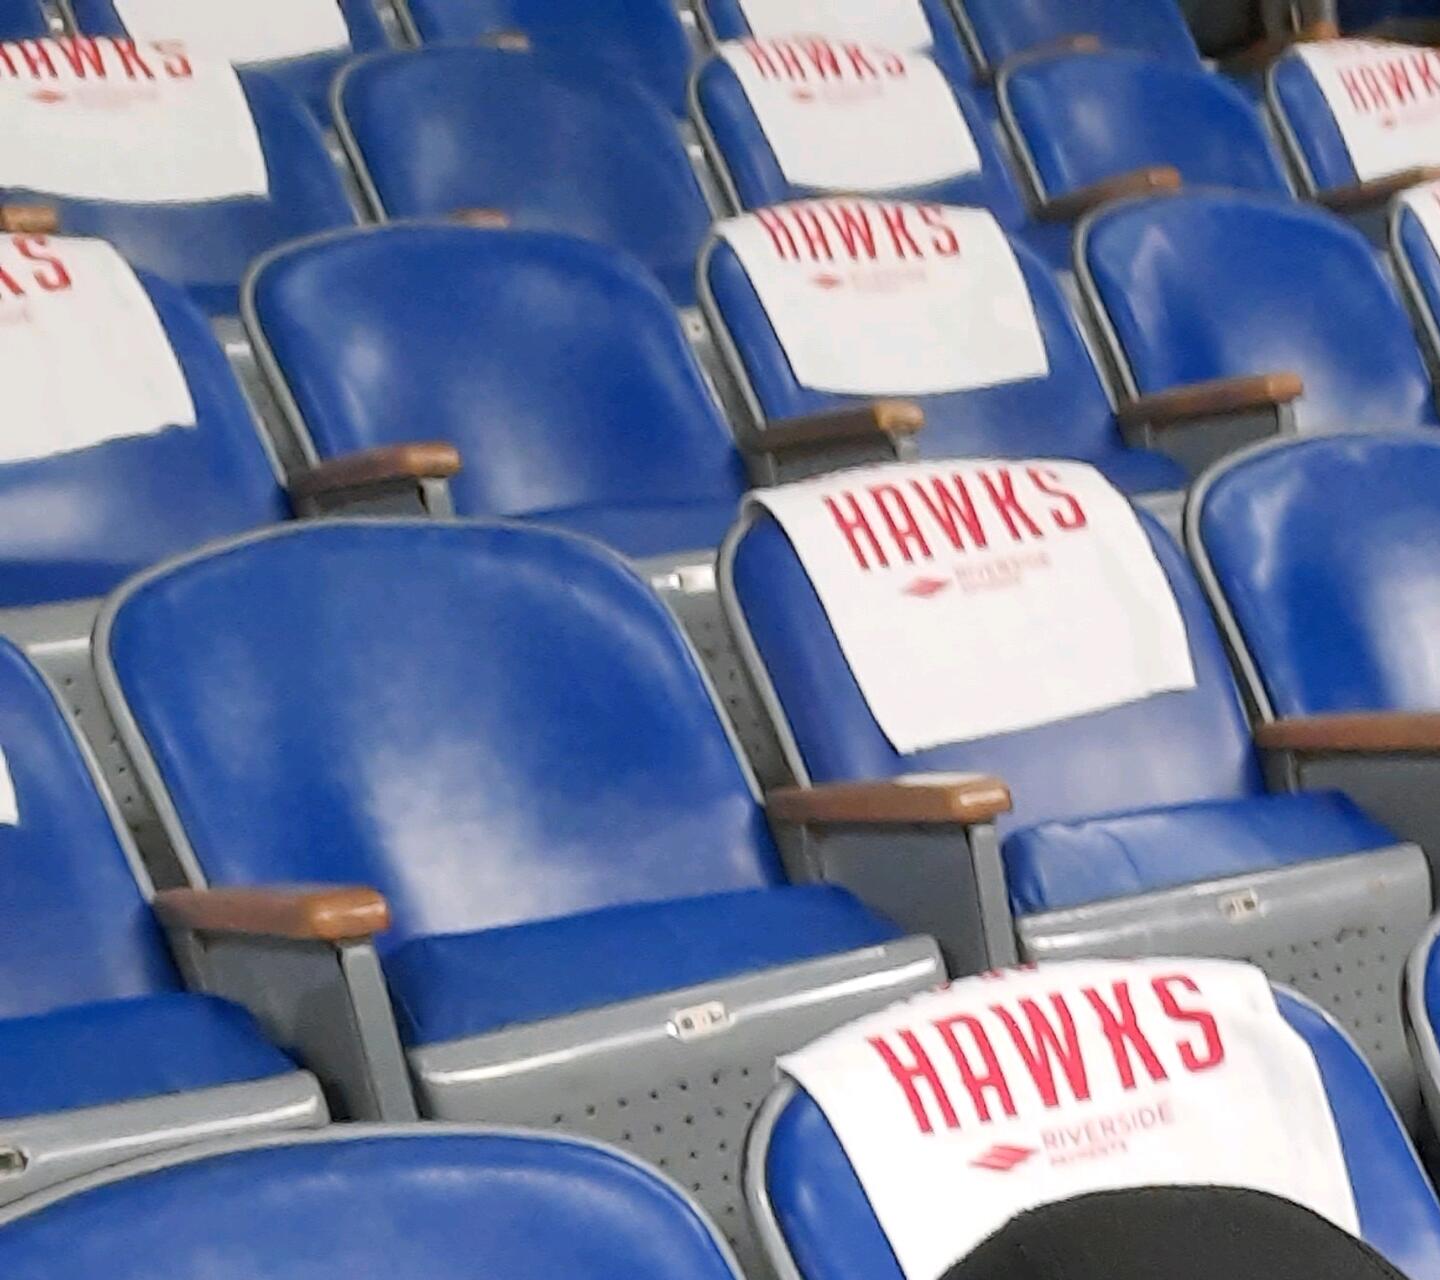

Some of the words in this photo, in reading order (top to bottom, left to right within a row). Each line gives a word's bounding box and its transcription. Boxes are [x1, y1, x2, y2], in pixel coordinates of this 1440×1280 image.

[754, 200, 961, 260] HAWKS
[823, 467, 1087, 571] HAWKS
[867, 974, 1225, 1134] HAWKS
[1040, 1098, 1174, 1150] RIVERSIDE
